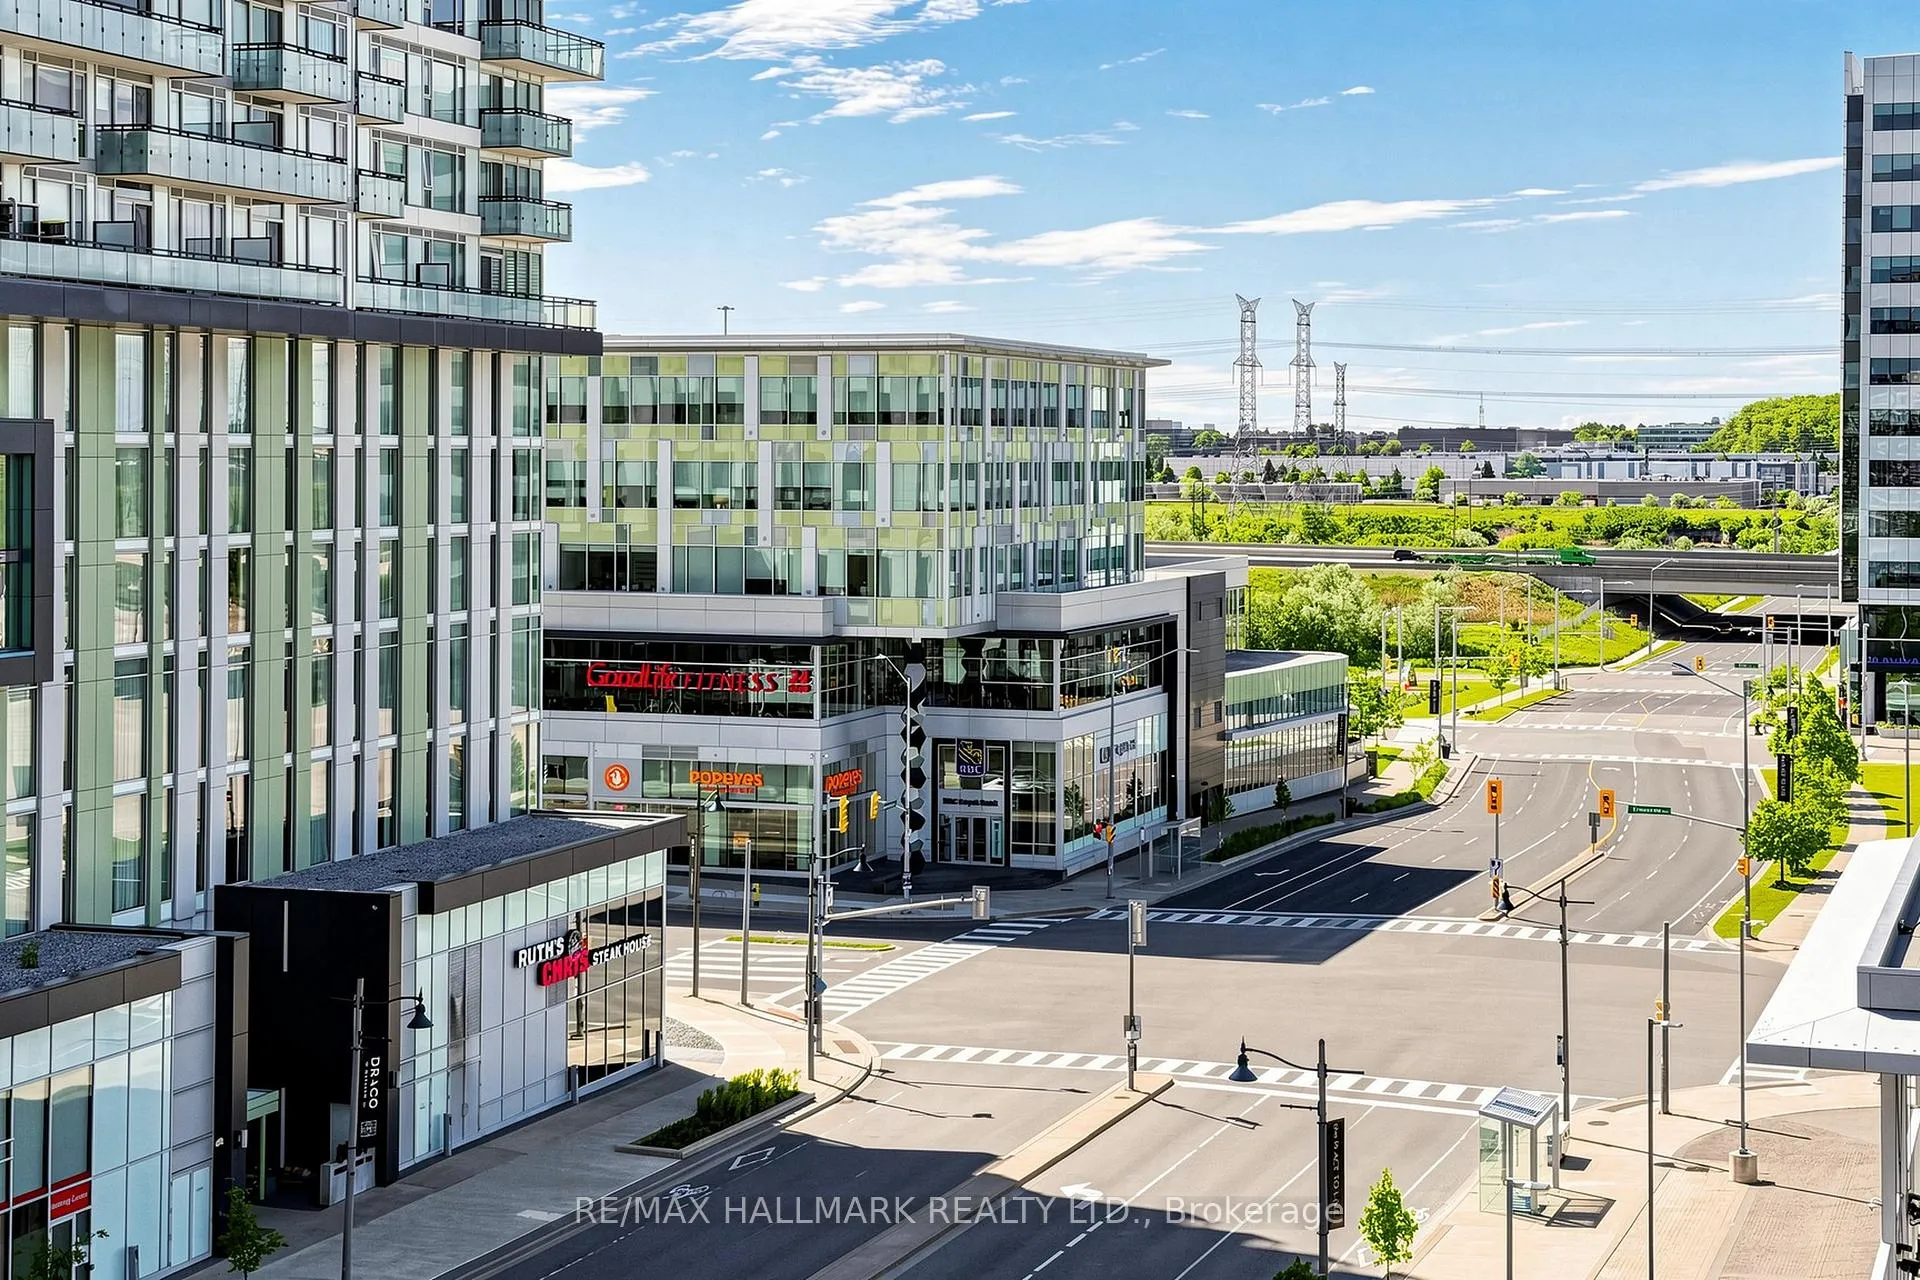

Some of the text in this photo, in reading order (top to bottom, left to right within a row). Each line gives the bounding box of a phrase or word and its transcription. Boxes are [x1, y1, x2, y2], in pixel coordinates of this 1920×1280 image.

[682, 672, 779, 693] FITNESS
[959, 765, 983, 775] RBC
[518, 936, 565, 969] RUTH'S
[592, 934, 653, 966] STEAK HOUSE
[368, 1056, 381, 1109] DRACO
